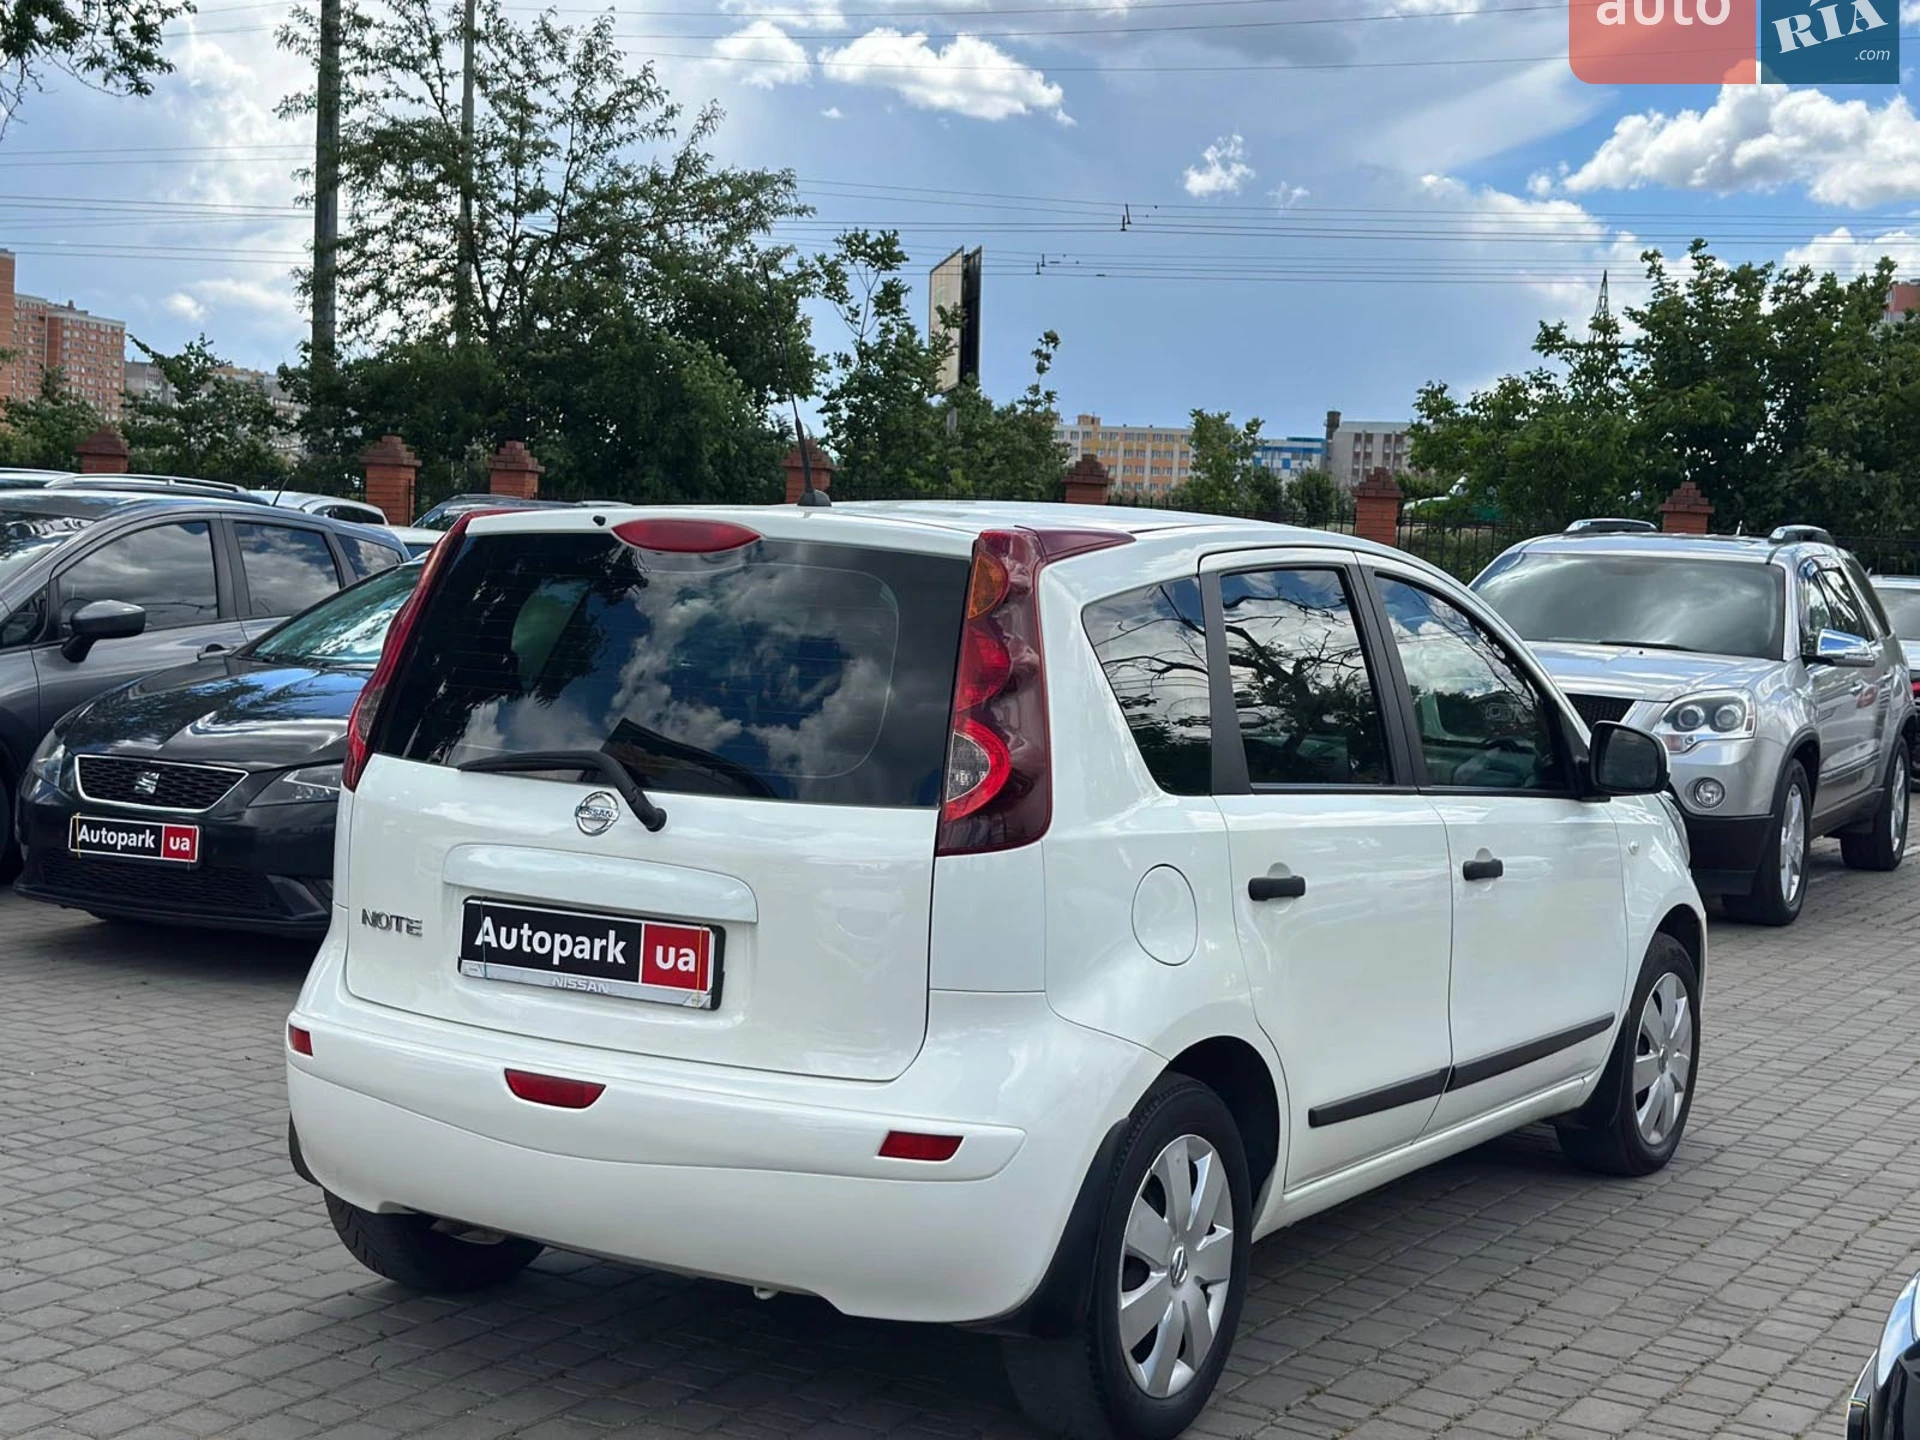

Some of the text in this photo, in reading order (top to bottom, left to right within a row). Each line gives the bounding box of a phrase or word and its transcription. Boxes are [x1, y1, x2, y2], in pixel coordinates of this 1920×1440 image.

[78, 824, 190, 851] Autopark ua
[361, 908, 423, 937] NOTE
[474, 916, 696, 972] Autopark ua
[552, 976, 609, 994] NISSAN
